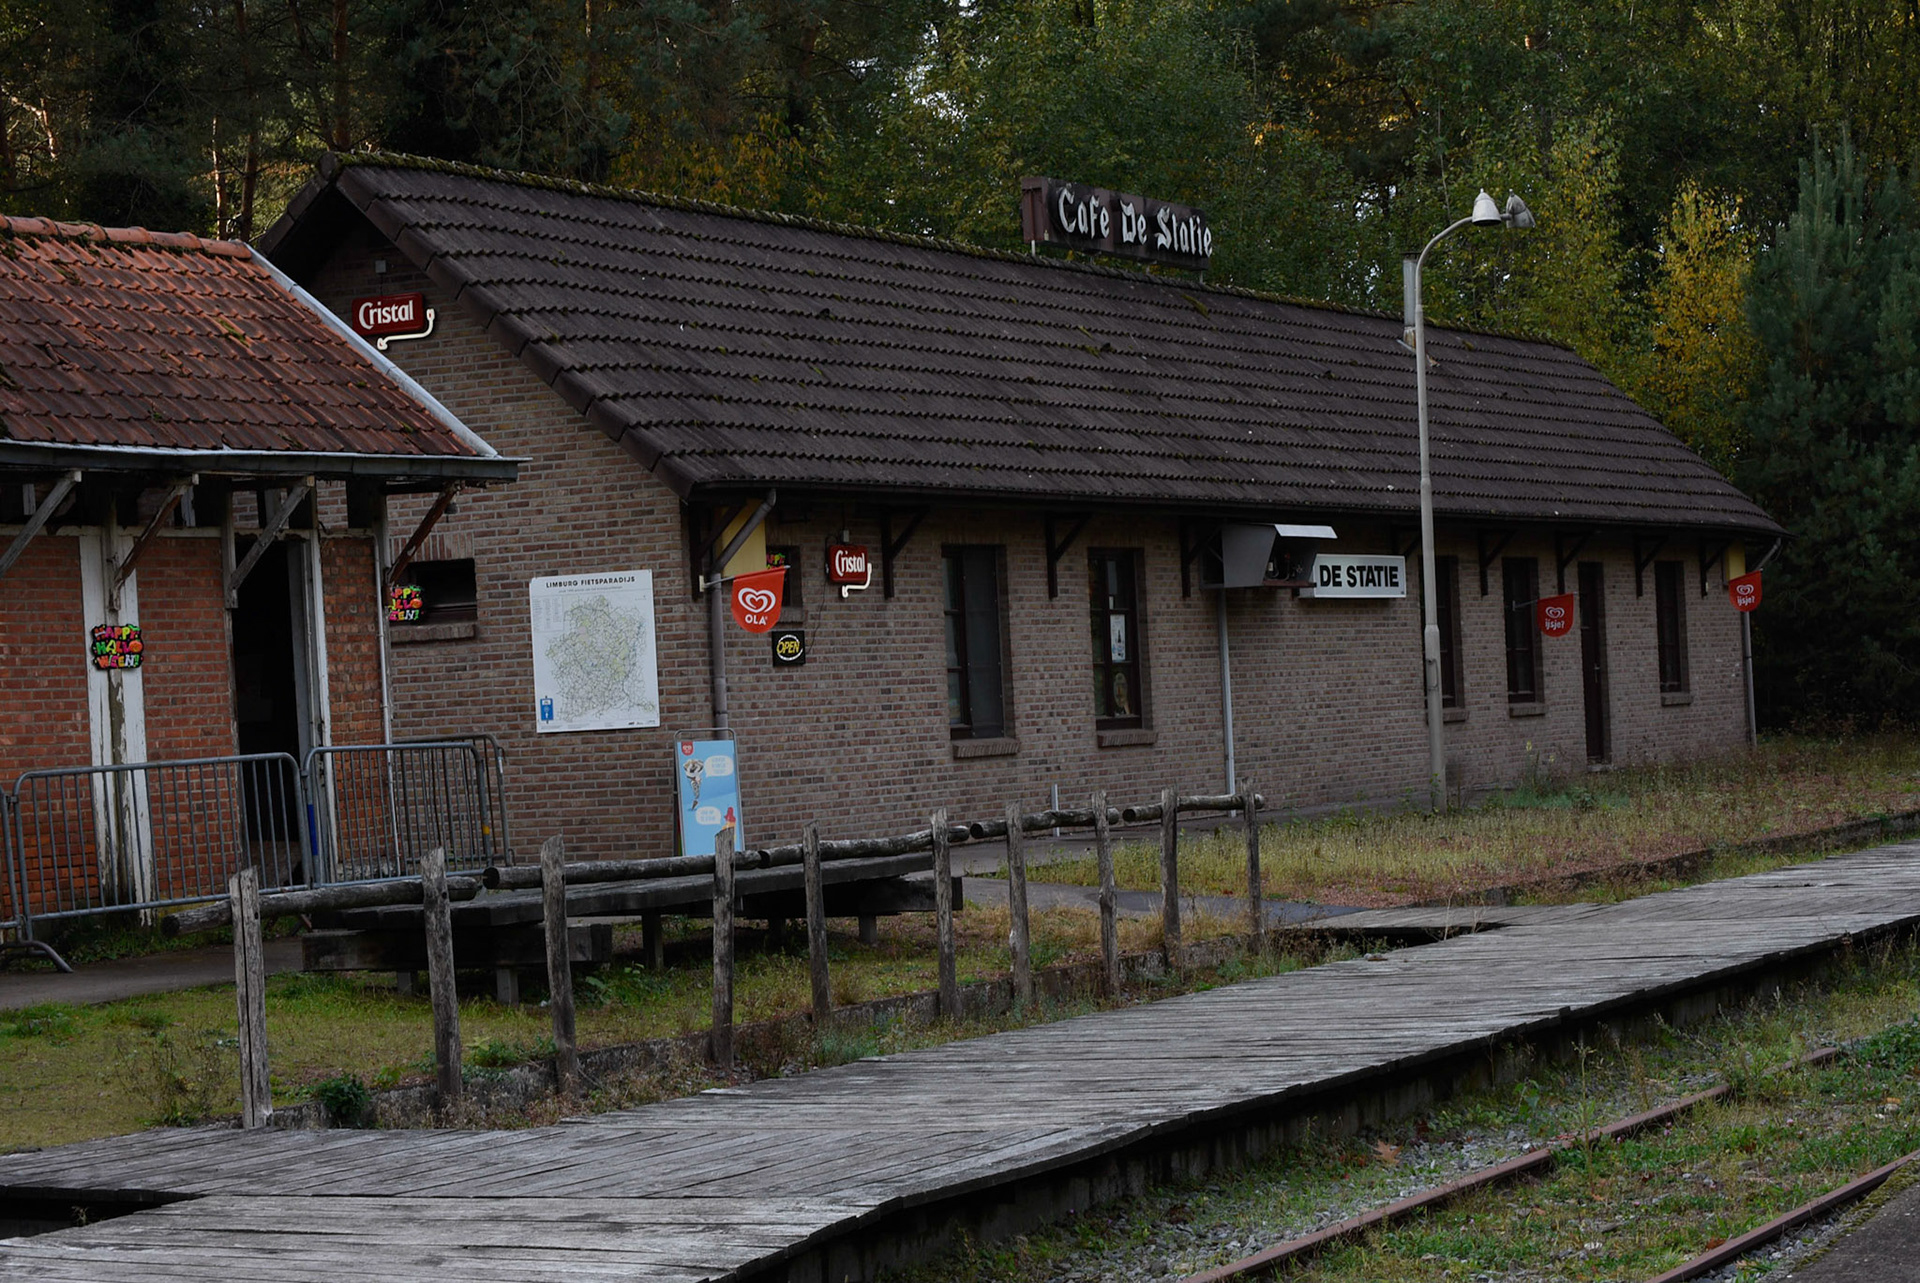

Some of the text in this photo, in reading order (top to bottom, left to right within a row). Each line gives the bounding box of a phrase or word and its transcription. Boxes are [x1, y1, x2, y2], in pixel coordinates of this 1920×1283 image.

[1120, 199, 1148, 245] De
[1154, 205, 1213, 258] Statie
[358, 299, 414, 330] Cristal
[834, 549, 866, 577] Cristal
[546, 576, 636, 589] LIMBURG FIETSPARADIJS
[1319, 565, 1400, 588] DE STATIE
[745, 614, 767, 625] OLA
[95, 639, 143, 655] HALLO
[776, 640, 800, 654] OPEN
